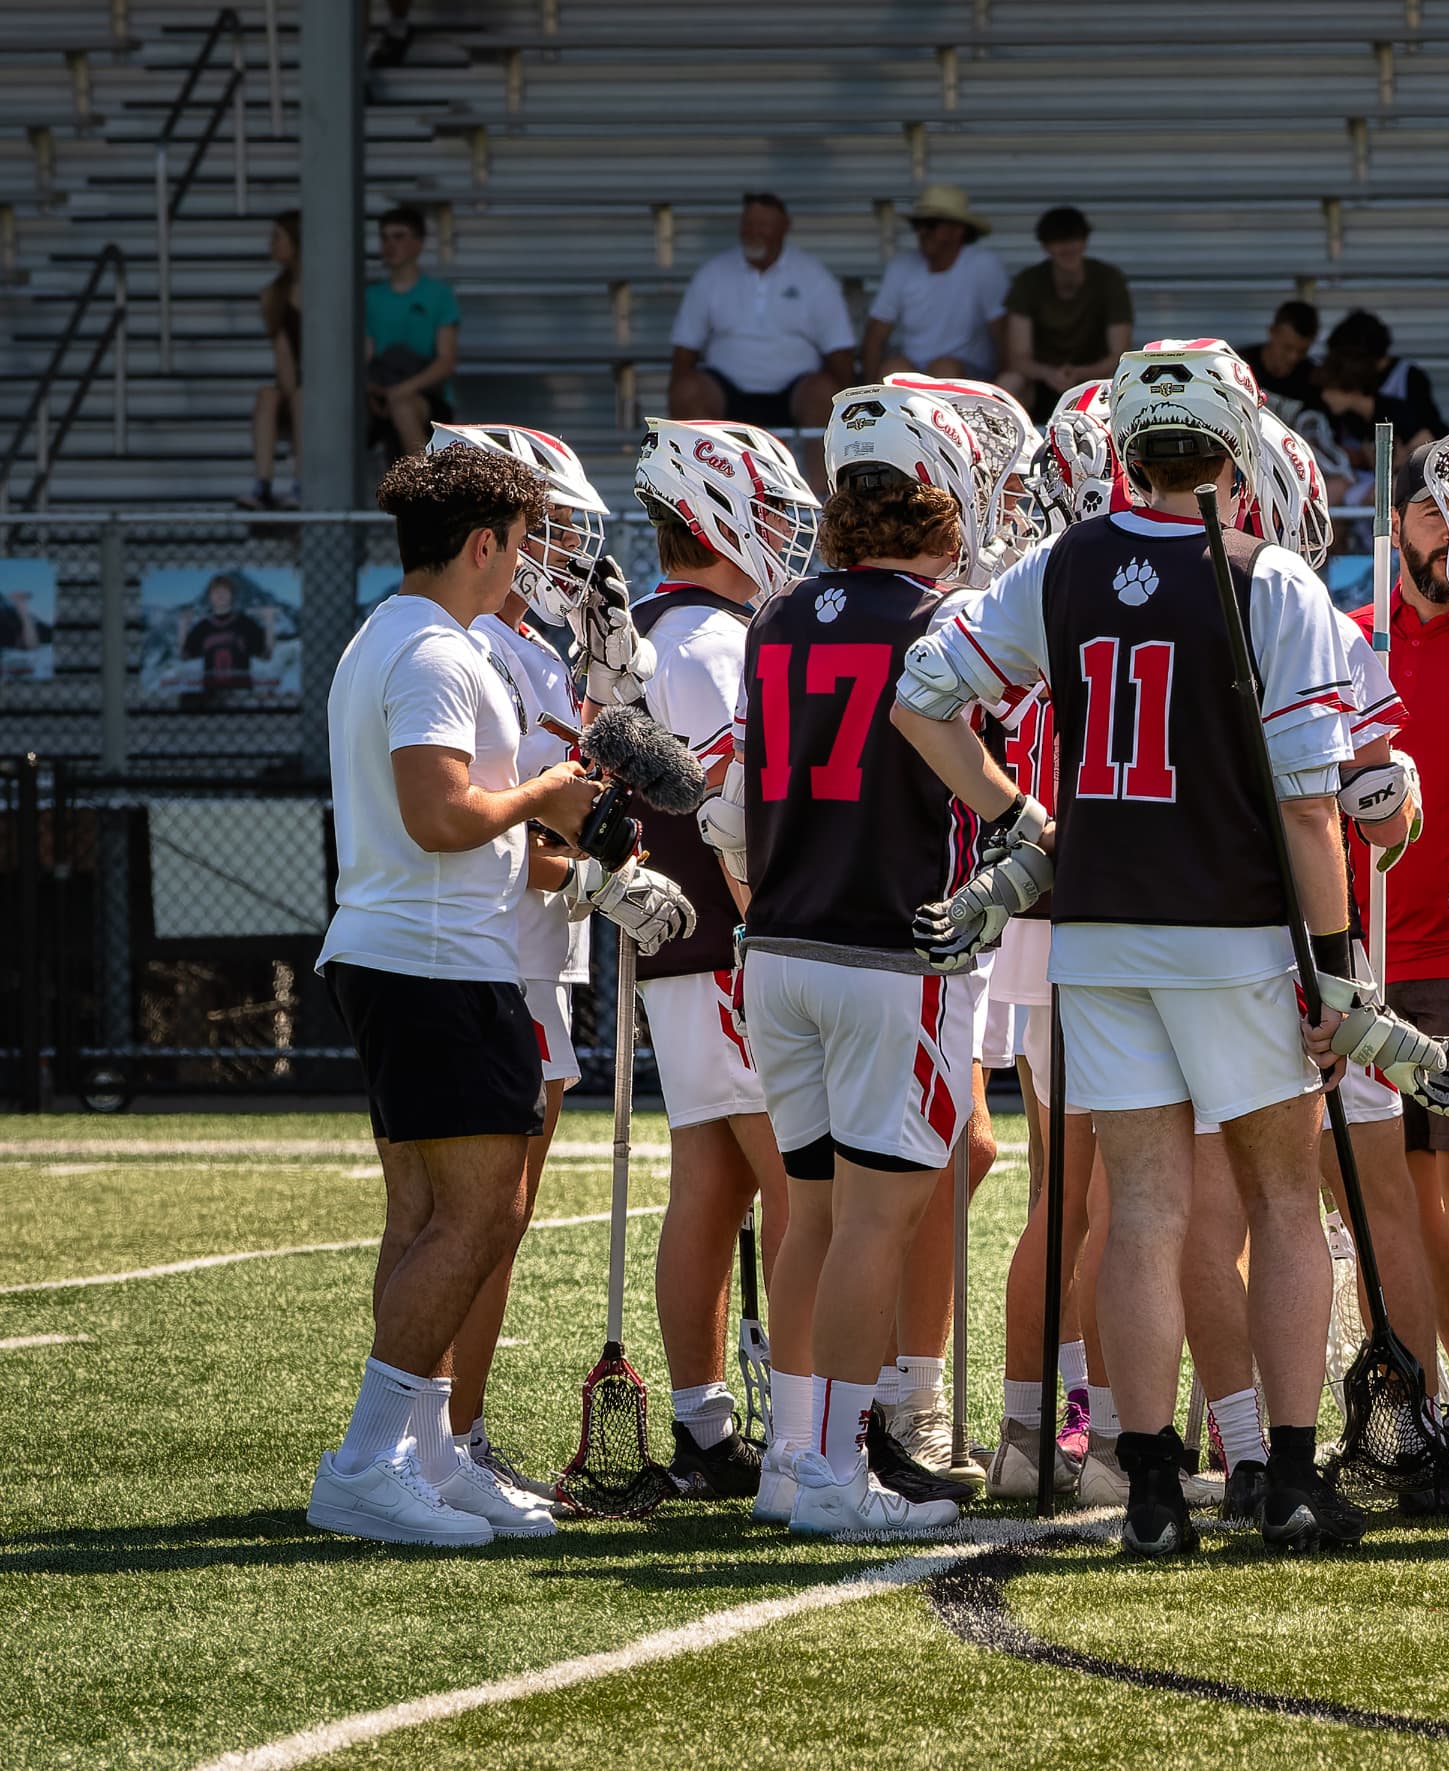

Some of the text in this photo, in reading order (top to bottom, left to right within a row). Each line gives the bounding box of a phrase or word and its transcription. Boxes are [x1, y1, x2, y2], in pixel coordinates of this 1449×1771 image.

[930, 406, 963, 447] Cats
[692, 438, 735, 478] Cats
[756, 643, 893, 802] 17
[1075, 636, 1177, 803] 11
[1358, 782, 1397, 811] STX
